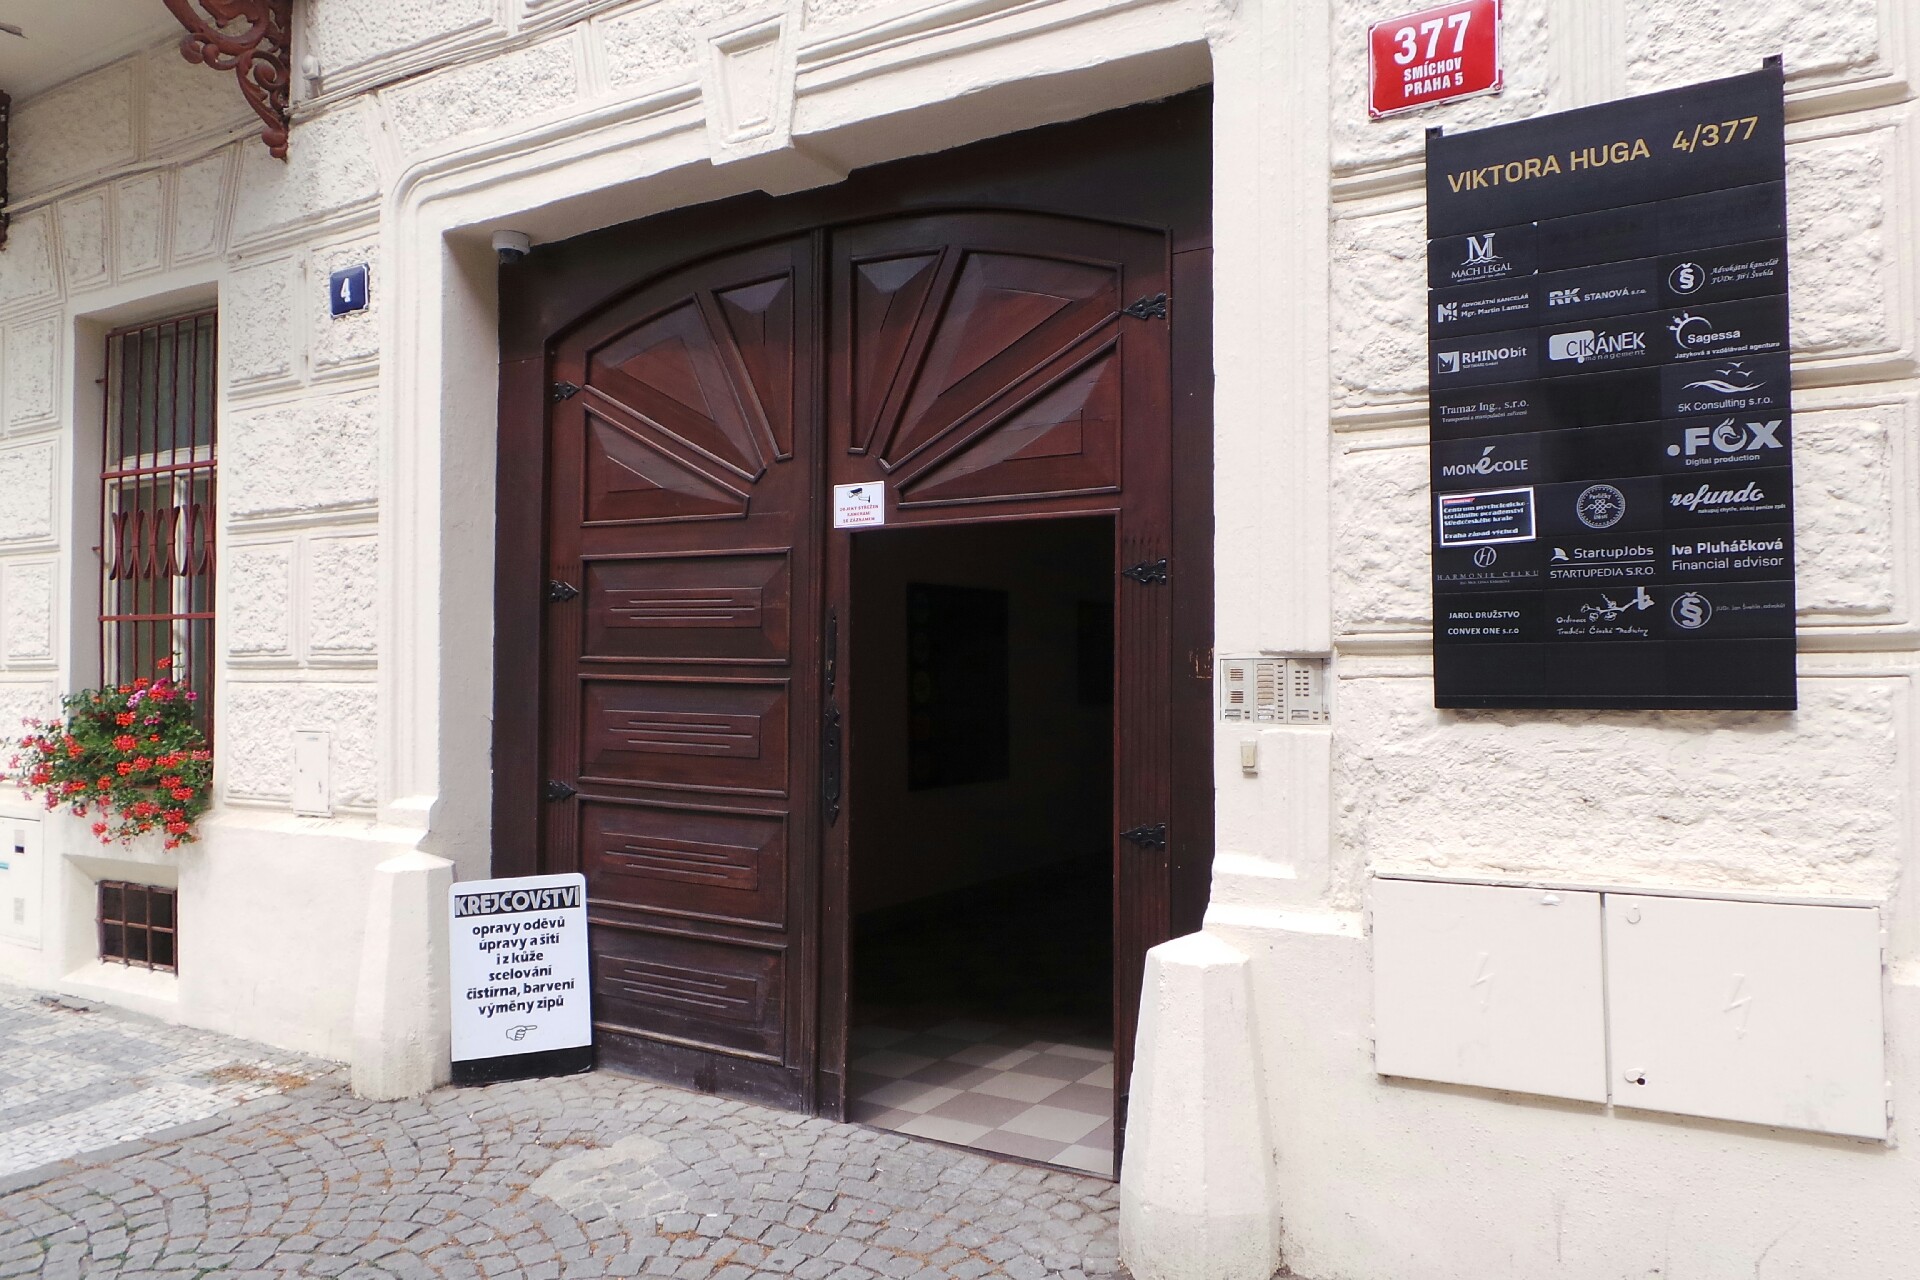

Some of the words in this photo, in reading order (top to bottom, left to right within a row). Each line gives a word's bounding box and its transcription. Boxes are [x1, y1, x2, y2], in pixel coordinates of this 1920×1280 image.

[1393, 11, 1472, 65] 377
[1403, 57, 1463, 81] SMÍCHOV
[1404, 75, 1452, 98] PRAHA
[1454, 72, 1464, 87] 5
[1447, 154, 1561, 193] VIKTORA
[1569, 138, 1651, 173] HUGA
[1672, 116, 1759, 153] 4/377
[1451, 266, 1481, 279] MACH
[1483, 262, 1513, 274] LEGAL
[340, 277, 351, 303] 4
[1549, 287, 1581, 306] RK
[1584, 287, 1629, 302] STANOVÁ
[1461, 298, 1496, 309] ADVOKÁTNÍ
[1496, 292, 1529, 304] KANCELÁŘ
[1461, 310, 1477, 318] Mgr.
[1477, 306, 1501, 315] Martin
[1687, 330, 1741, 345] Sagessa
[1462, 347, 1528, 364] RHINObit
[1584, 349, 1646, 361] management
[1674, 350, 1705, 360] Jazyková
[1749, 341, 1781, 351] agentura
[1440, 404, 1477, 415] Tramaz
[1504, 399, 1530, 409] s.r.o.
[1678, 403, 1692, 413] SK
[1693, 398, 1746, 411] Consulting
[1748, 396, 1774, 406] s.r.o.
[1685, 457, 1712, 467] Digital
[1713, 454, 1761, 465] production
[1443, 506, 1475, 514] Centrum
[1574, 545, 1654, 559] StartupJobs
[1671, 544, 1693, 556] Iva
[1697, 537, 1784, 554] Pluháčková
[1672, 558, 1729, 571] Financial
[1733, 556, 1785, 568] advisor
[1437, 572, 1495, 581] HARMONIE
[1502, 570, 1540, 578] CELKU
[1550, 567, 1623, 579] STARTUPEDIA
[1625, 567, 1656, 577] S.R.O.
[1448, 612, 1474, 620] JAROL
[1475, 609, 1520, 619] DRUŽSTVO
[1447, 628, 1481, 636] CONVEX
[1482, 627, 1501, 635] ONE
[454, 886, 581, 916] KREJČOVSTVÍ
[472, 922, 521, 938] opravy
[523, 916, 566, 931] oděvů
[479, 937, 528, 953] úpravy
[529, 937, 538, 946] a
[539, 933, 560, 945] šití
[496, 953, 501, 965] i
[502, 955, 509, 964] z
[511, 951, 544, 964] kůže
[488, 965, 553, 982] scelování
[466, 985, 521, 1001] čistírna,
[523, 978, 575, 995] barvení
[478, 999, 535, 1018] výměny
